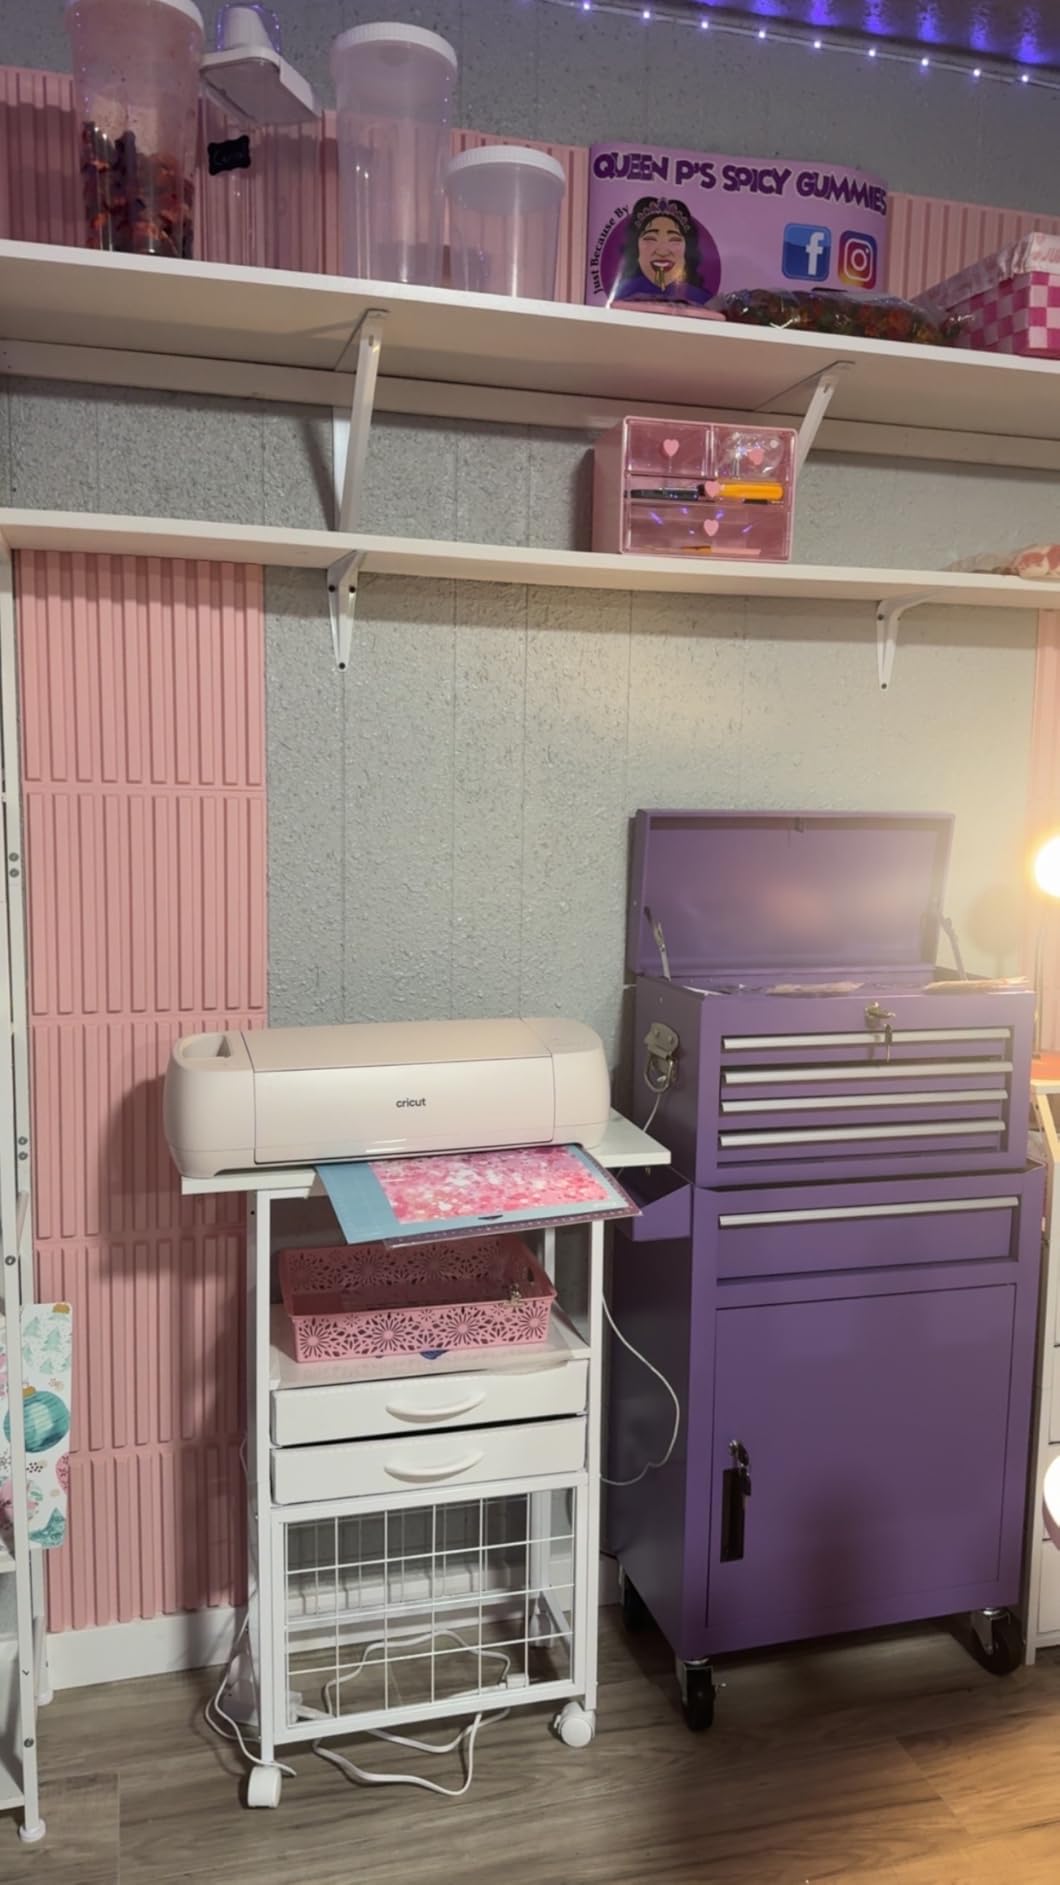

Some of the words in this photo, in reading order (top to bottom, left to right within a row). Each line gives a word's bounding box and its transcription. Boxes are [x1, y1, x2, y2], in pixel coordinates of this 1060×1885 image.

[592, 151, 669, 181] QUEEN
[675, 159, 717, 189] P'S
[722, 164, 792, 195] SPICY
[796, 171, 887, 216] GUMMIES
[613, 204, 630, 219] By
[590, 218, 616, 267] Because
[591, 269, 604, 295] Just
[395, 1097, 427, 1108] cricut
